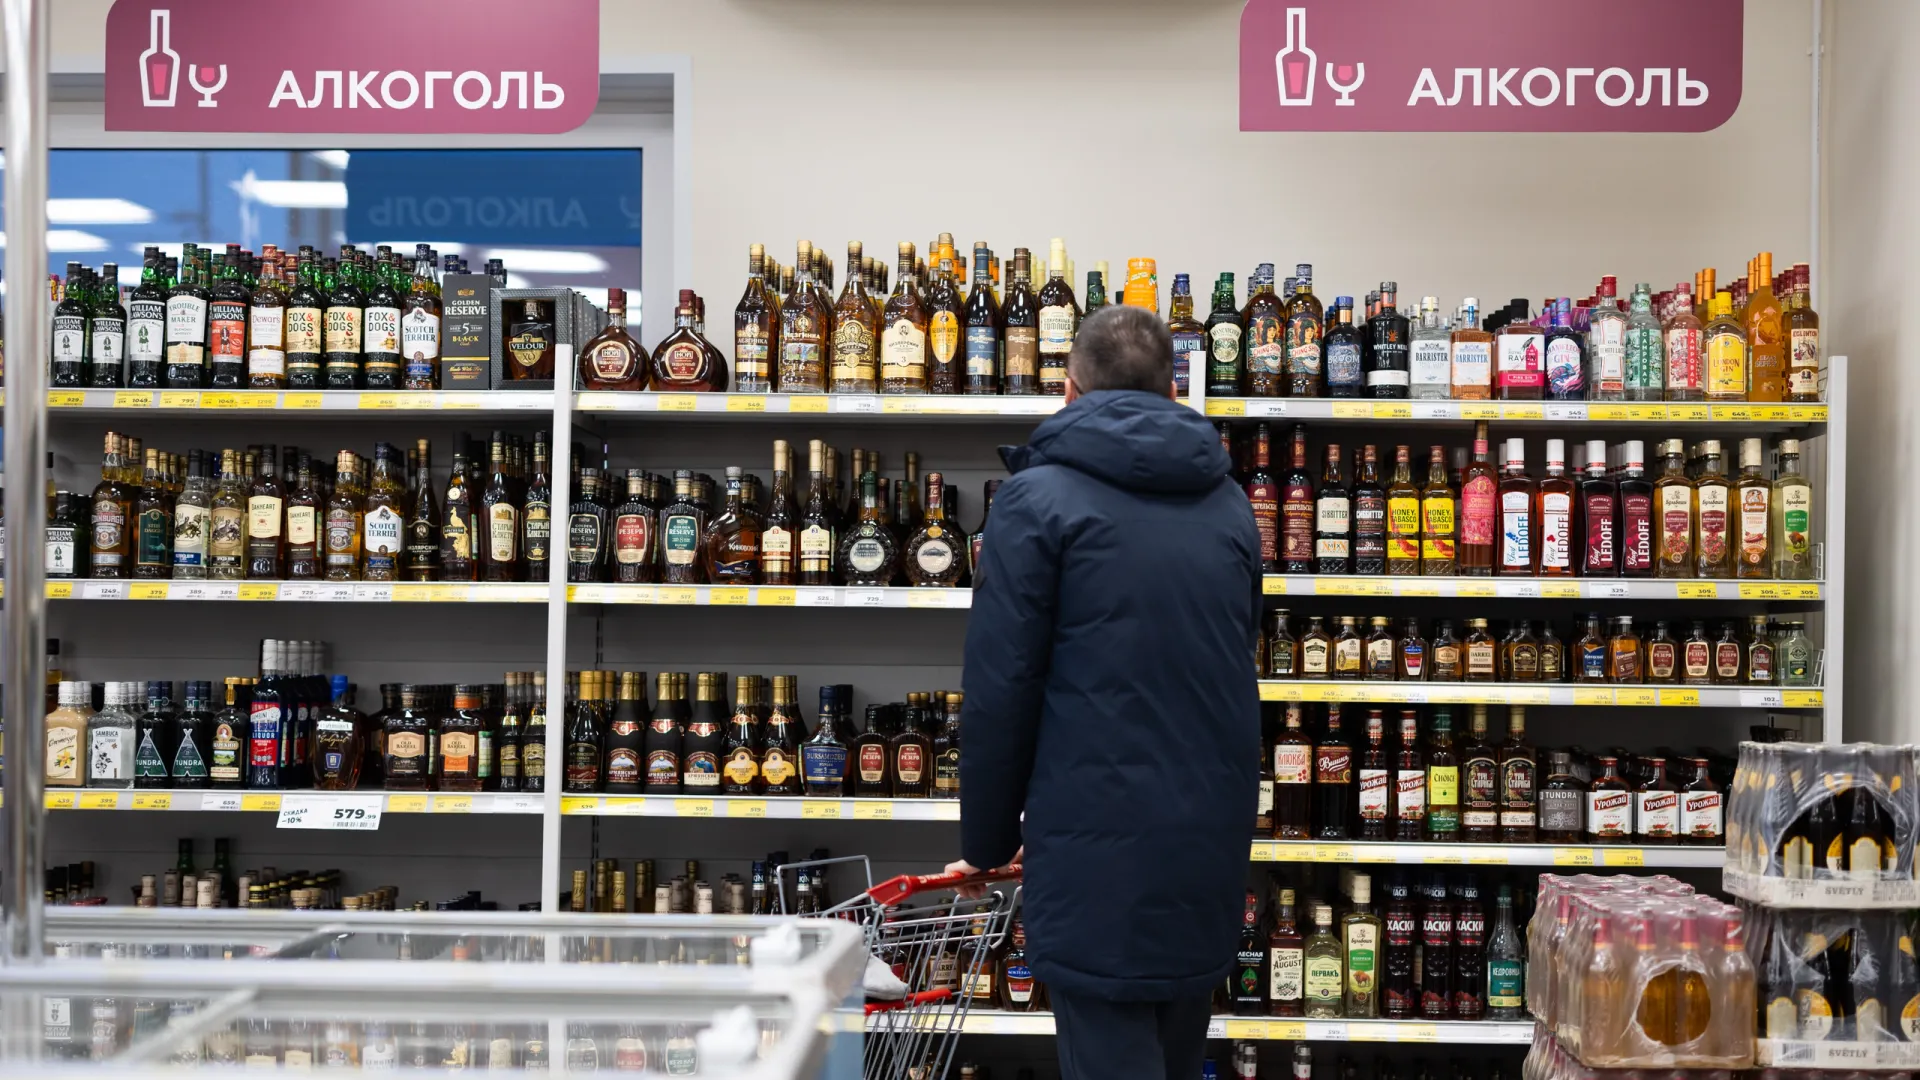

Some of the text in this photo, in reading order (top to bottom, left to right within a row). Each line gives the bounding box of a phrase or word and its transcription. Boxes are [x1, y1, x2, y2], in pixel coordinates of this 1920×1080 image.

[269, 71, 564, 109] АЛКОГОЛЬ
[1408, 68, 1708, 106] АЛКОГОЛЬ
[169, 302, 200, 312] TROUBLE
[445, 306, 487, 316] RESERVE
[252, 315, 280, 323] Dewar's
[288, 322, 314, 332] DOGS
[328, 322, 353, 332] DOGS
[368, 322, 395, 332] DOGS
[462, 322, 470, 335] 5
[405, 334, 435, 342] TERRIER
[1173, 339, 1188, 351] HOLY
[1328, 355, 1360, 364] BROOM
[1416, 352, 1448, 362] BARRISTER
[1456, 353, 1488, 363] BARRISTER
[1554, 354, 1570, 363] GIN
[1714, 358, 1740, 367] LONDON
[1518, 516, 1529, 559] LEDOFF
[1558, 517, 1569, 559] LEDOFF
[1601, 518, 1612, 562] LEDOFF
[1638, 519, 1649, 562] LEDOFF
[1278, 754, 1305, 766] КЛЮКВА
[1434, 773, 1455, 782] CHOICE
[1360, 776, 1387, 791] Урожай
[1597, 796, 1627, 809] Урожай
[1646, 797, 1675, 810] Урожай
[1688, 797, 1718, 810] Урожай
[283, 808, 308, 817] СКИДКА
[1387, 920, 1414, 931] ХАСКИ
[1423, 920, 1451, 932] ХАСКИ
[1456, 920, 1484, 932] ХАСКИ
[1273, 959, 1302, 970] AUGUST
